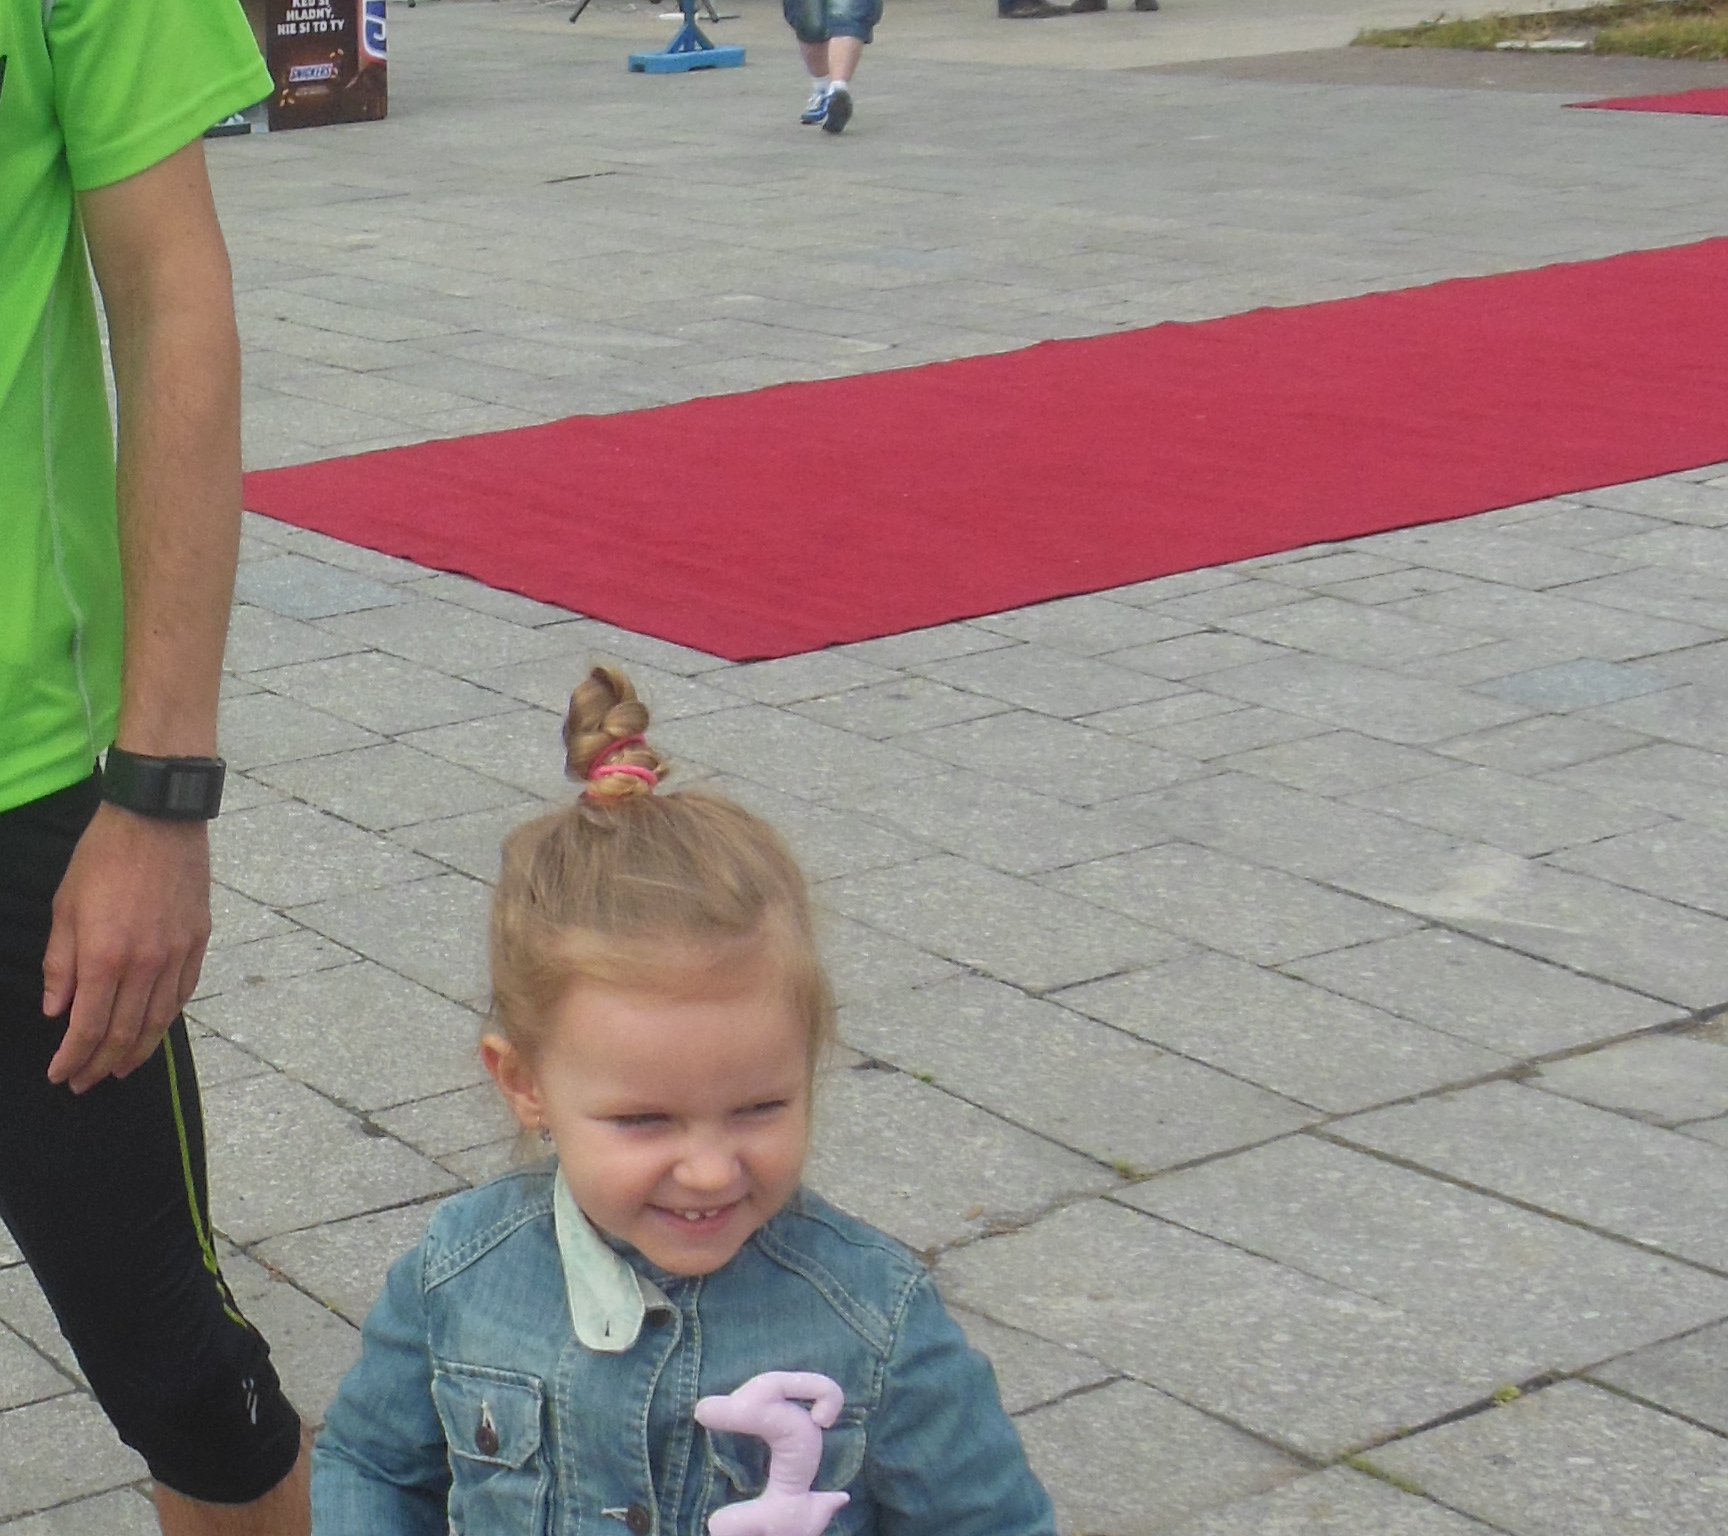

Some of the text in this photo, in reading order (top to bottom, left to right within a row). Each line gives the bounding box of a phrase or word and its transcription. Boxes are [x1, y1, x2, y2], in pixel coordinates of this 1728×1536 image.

[277, 19, 345, 35] NIE SI TO TY
